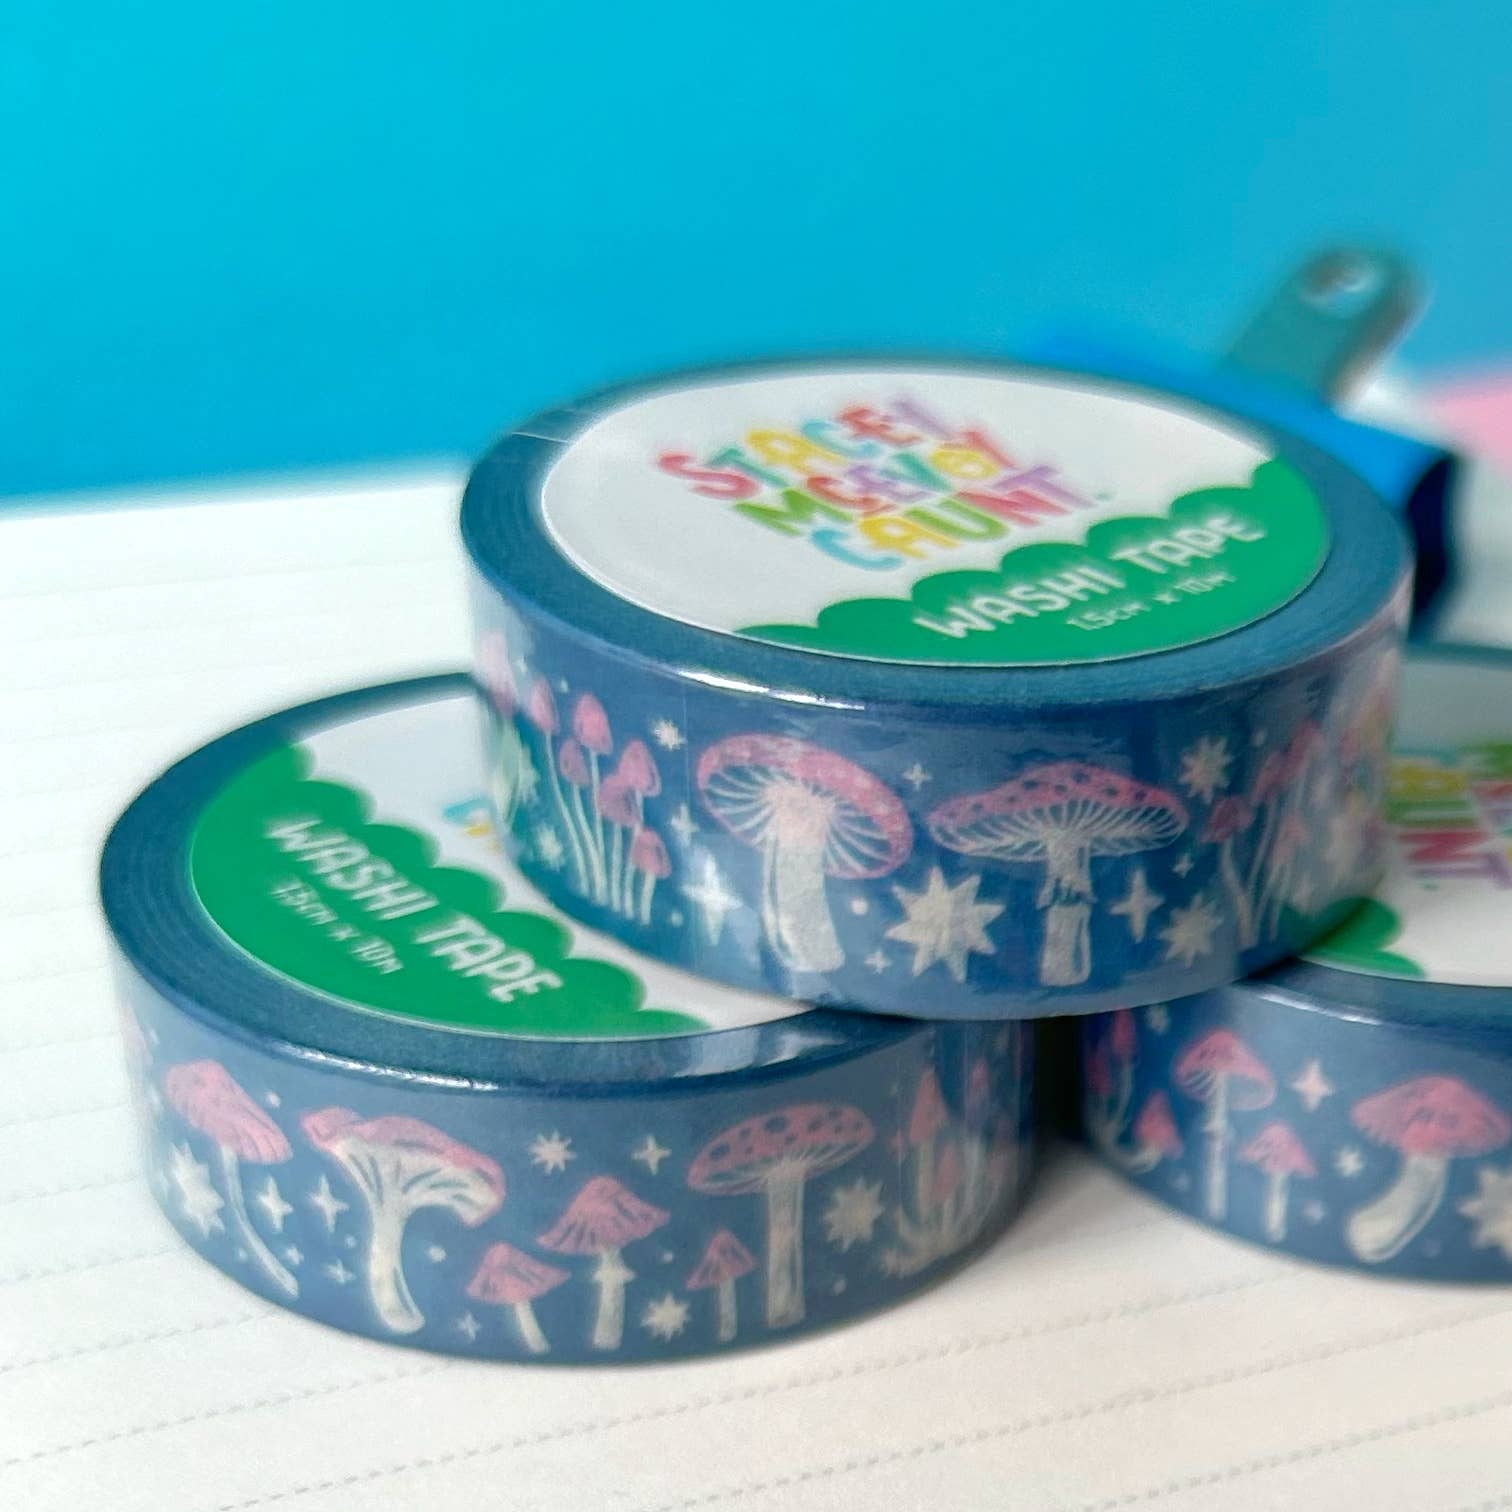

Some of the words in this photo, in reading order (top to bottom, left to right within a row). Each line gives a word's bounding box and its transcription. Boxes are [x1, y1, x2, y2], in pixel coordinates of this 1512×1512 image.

[657, 398, 953, 497] STACEY
[912, 565, 1125, 638] WASHI
[1109, 515, 1266, 573] TAPE
[267, 819, 440, 921] WASHI
[413, 914, 564, 1003] TAPE
